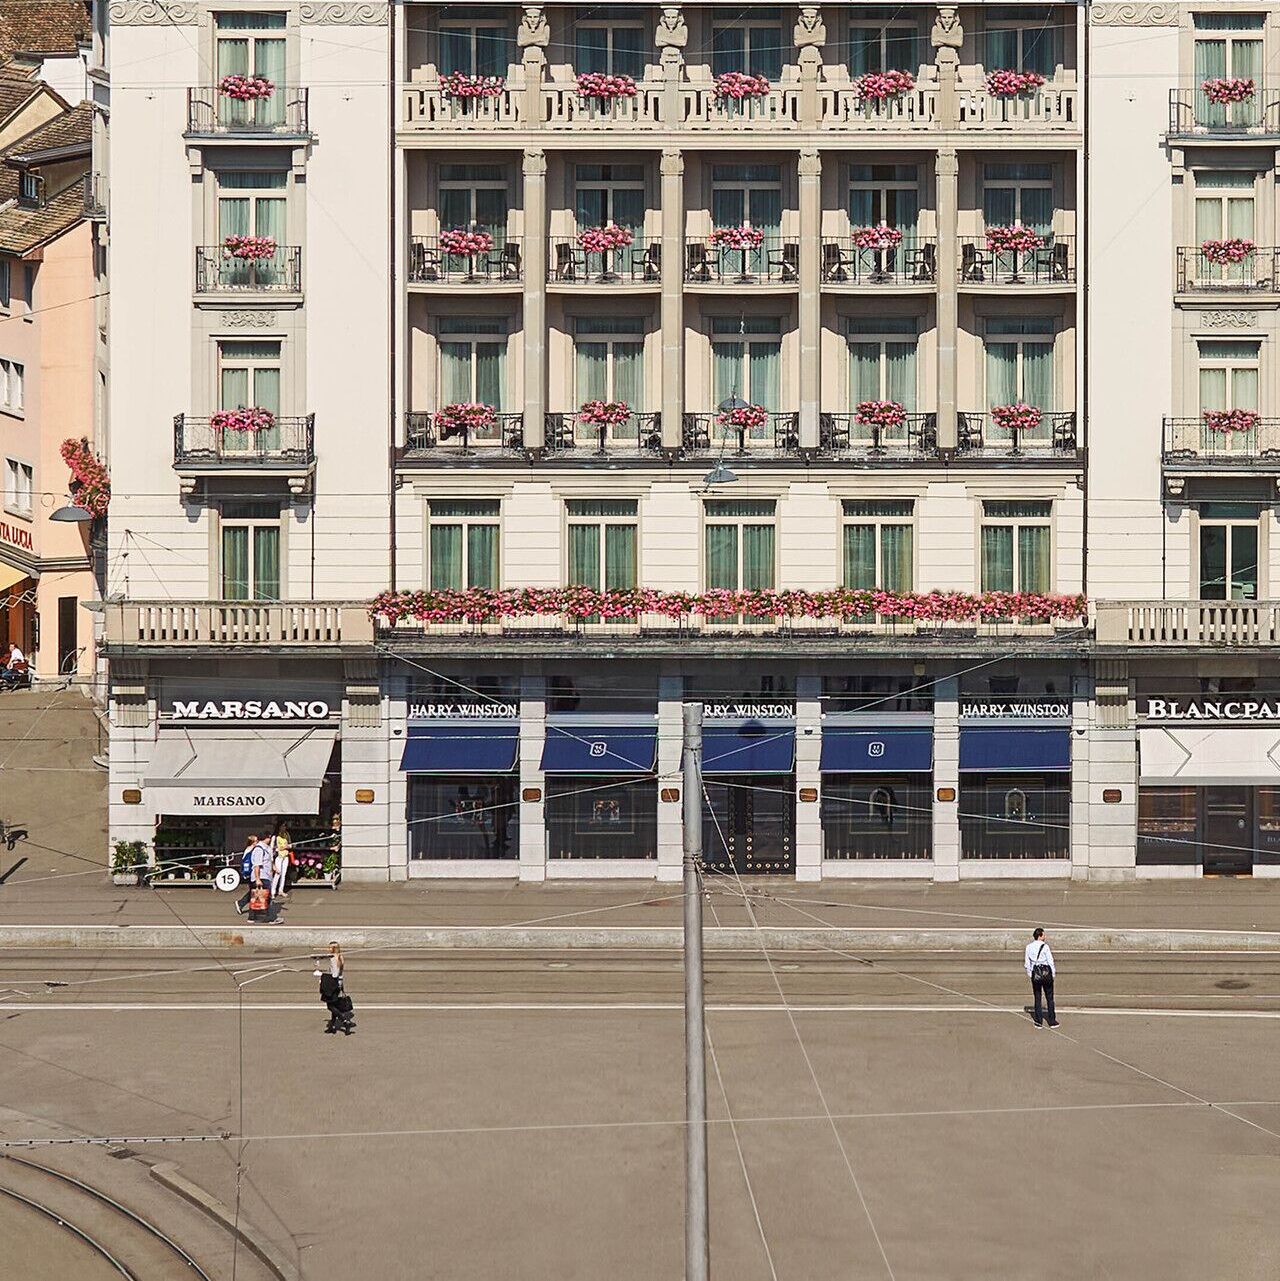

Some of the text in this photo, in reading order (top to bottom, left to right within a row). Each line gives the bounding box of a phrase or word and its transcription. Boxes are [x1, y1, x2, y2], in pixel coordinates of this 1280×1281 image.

[11, 525, 34, 551] LUCIA
[172, 701, 329, 719] MARSANO
[410, 704, 517, 716] HARRY WINSTON
[704, 704, 793, 716] RRY WINSTON
[962, 704, 1069, 716] HARRY WINSTON
[193, 796, 266, 806] MARSANO
[222, 874, 235, 885] 15
